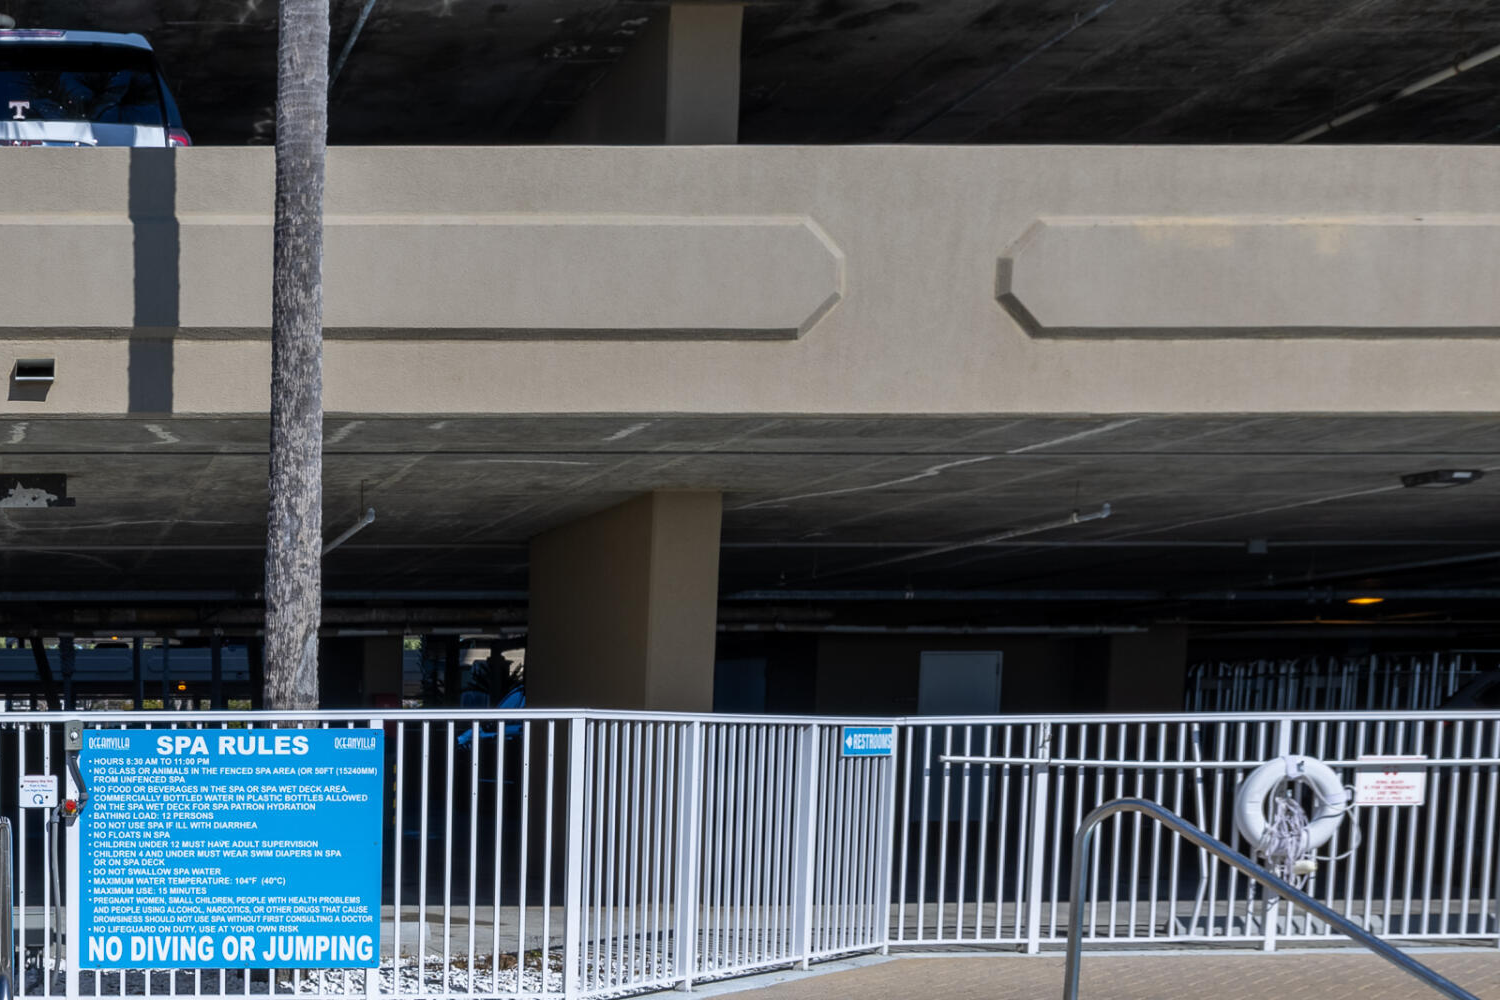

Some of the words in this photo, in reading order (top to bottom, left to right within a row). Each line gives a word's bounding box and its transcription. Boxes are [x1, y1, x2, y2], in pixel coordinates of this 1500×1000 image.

[89, 738, 130, 749] OCEANVILLA
[156, 736, 209, 755] SPA
[219, 736, 308, 755] RULES
[335, 738, 375, 749] OCEANVILLA
[853, 734, 892, 749] RESTROOMS
[298, 768, 312, 776] (OR
[262, 877, 285, 885] (40°C)
[89, 936, 122, 961] NO
[131, 936, 214, 961] DIVING
[222, 936, 256, 961] OR
[263, 935, 373, 961] JUMPING
